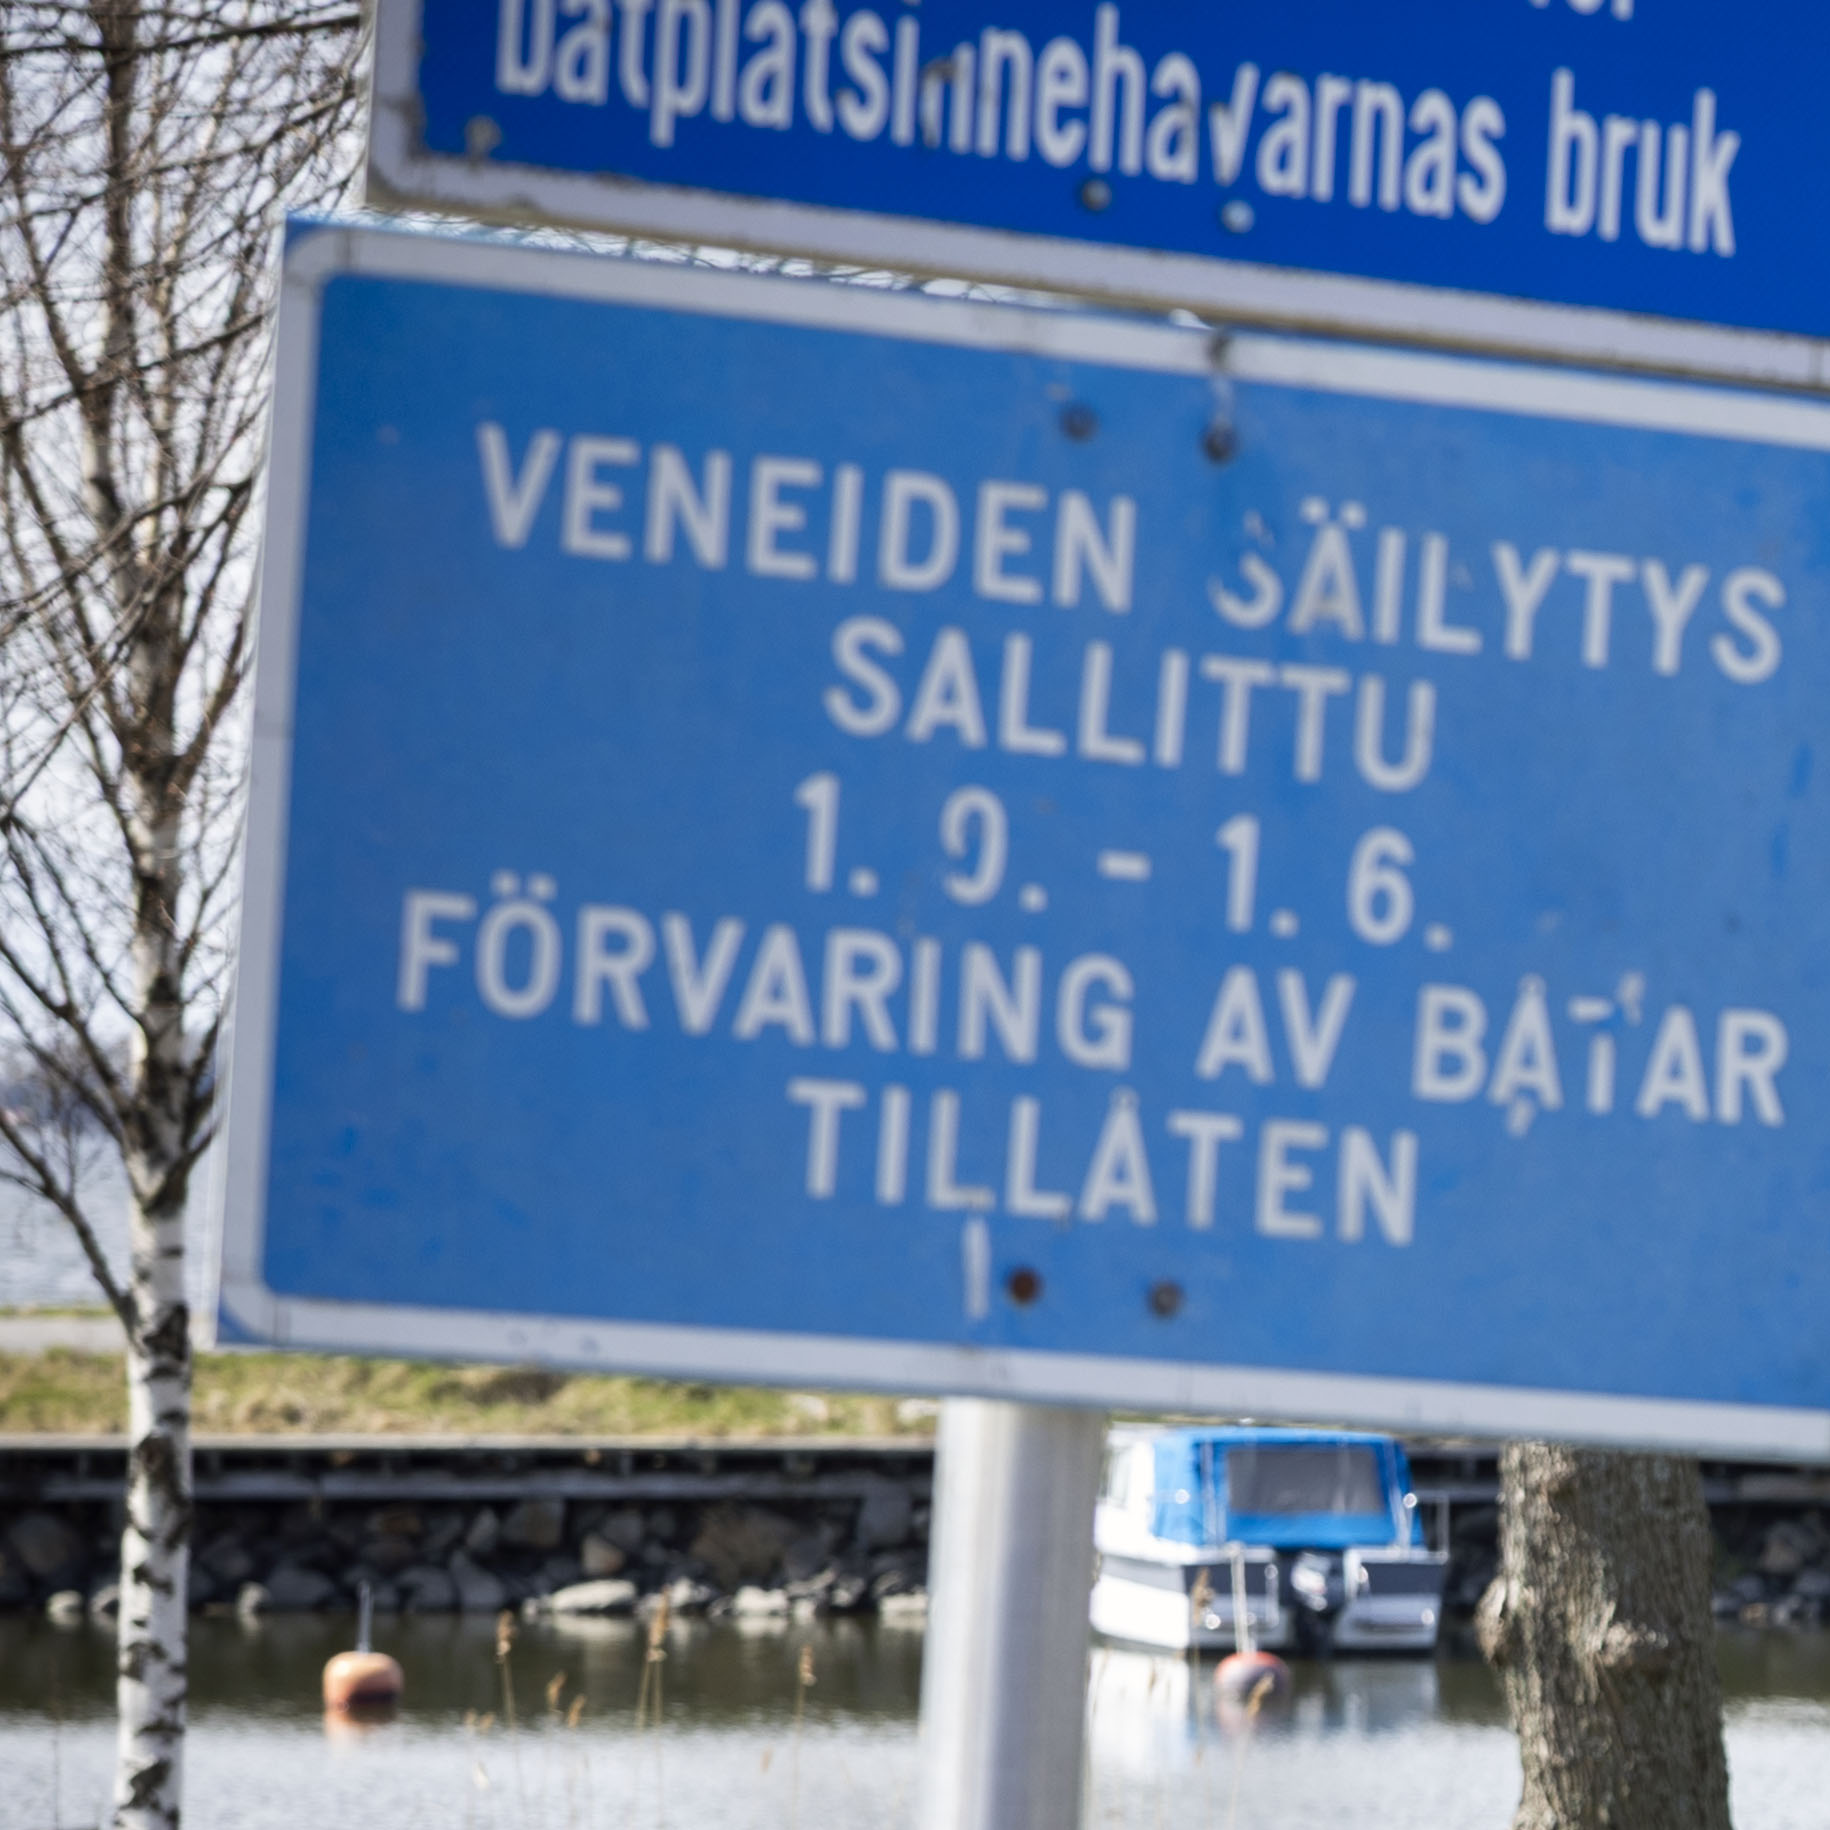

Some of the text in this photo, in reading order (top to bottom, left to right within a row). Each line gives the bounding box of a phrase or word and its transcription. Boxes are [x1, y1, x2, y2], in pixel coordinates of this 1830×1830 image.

[1545, 66, 1741, 257] bruk
[477, 421, 1787, 686] VENEIDEN SÄILYTYS
[822, 613, 1438, 792] SALLITTU
[400, 871, 1136, 1076] FÖRVARING
[1194, 963, 1357, 1090] AV
[786, 1077, 1420, 1246] TILLÅTEN
